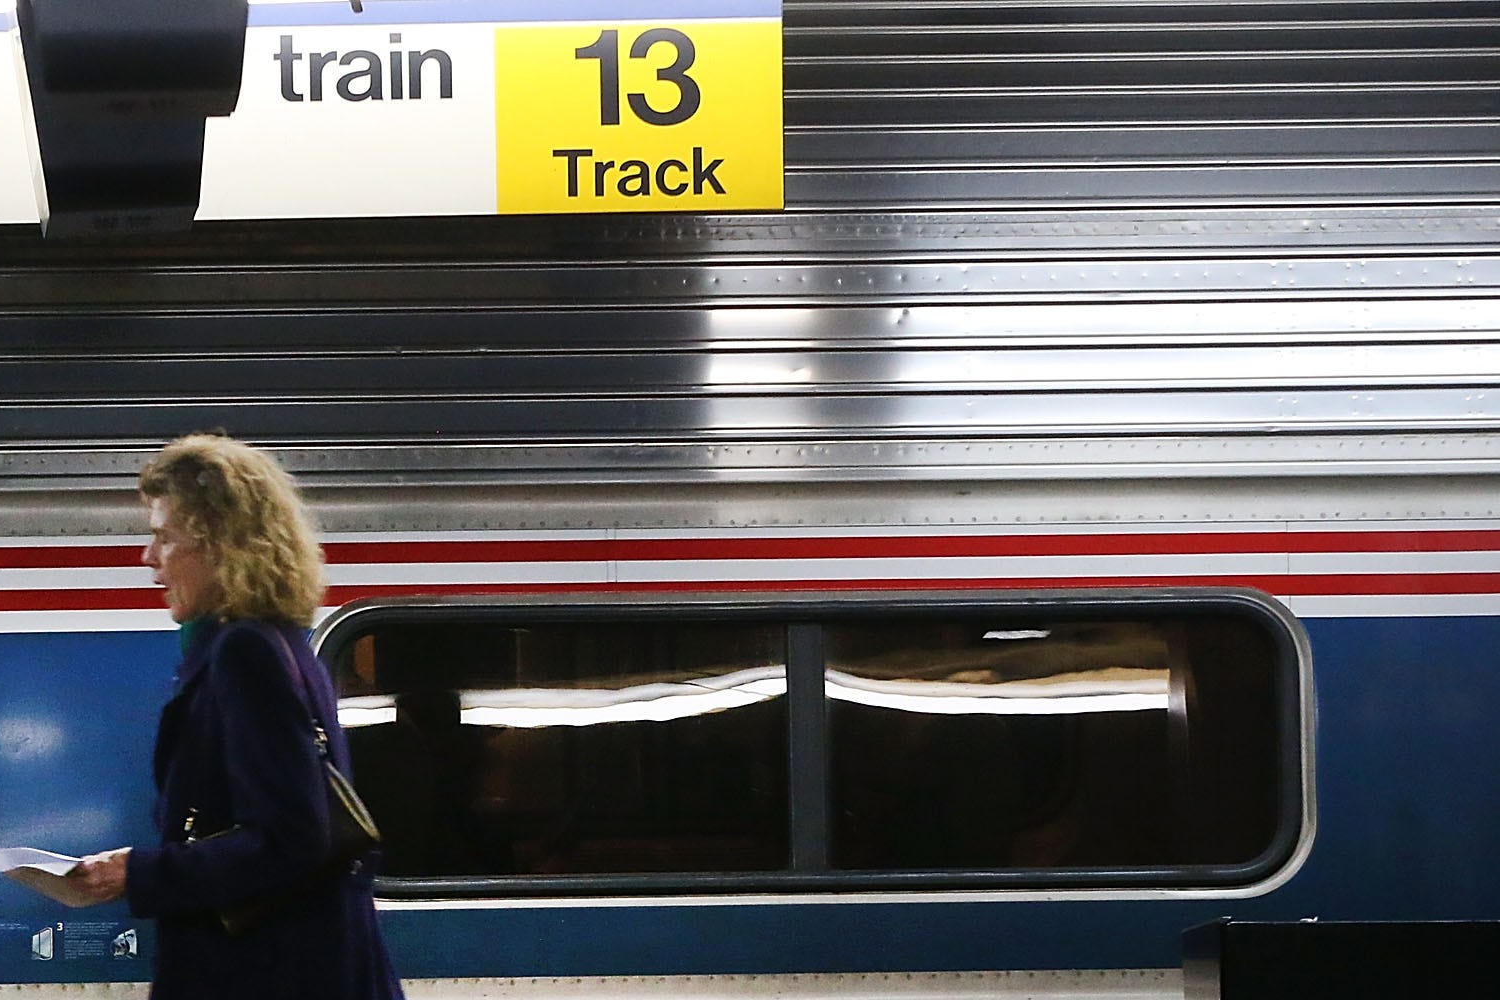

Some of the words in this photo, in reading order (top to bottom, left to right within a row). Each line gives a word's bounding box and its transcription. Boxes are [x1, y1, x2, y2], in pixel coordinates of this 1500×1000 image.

[273, 34, 453, 102] train
[575, 28, 702, 127] 13
[552, 147, 727, 198] Track
[56, 922, 64, 931] 3
